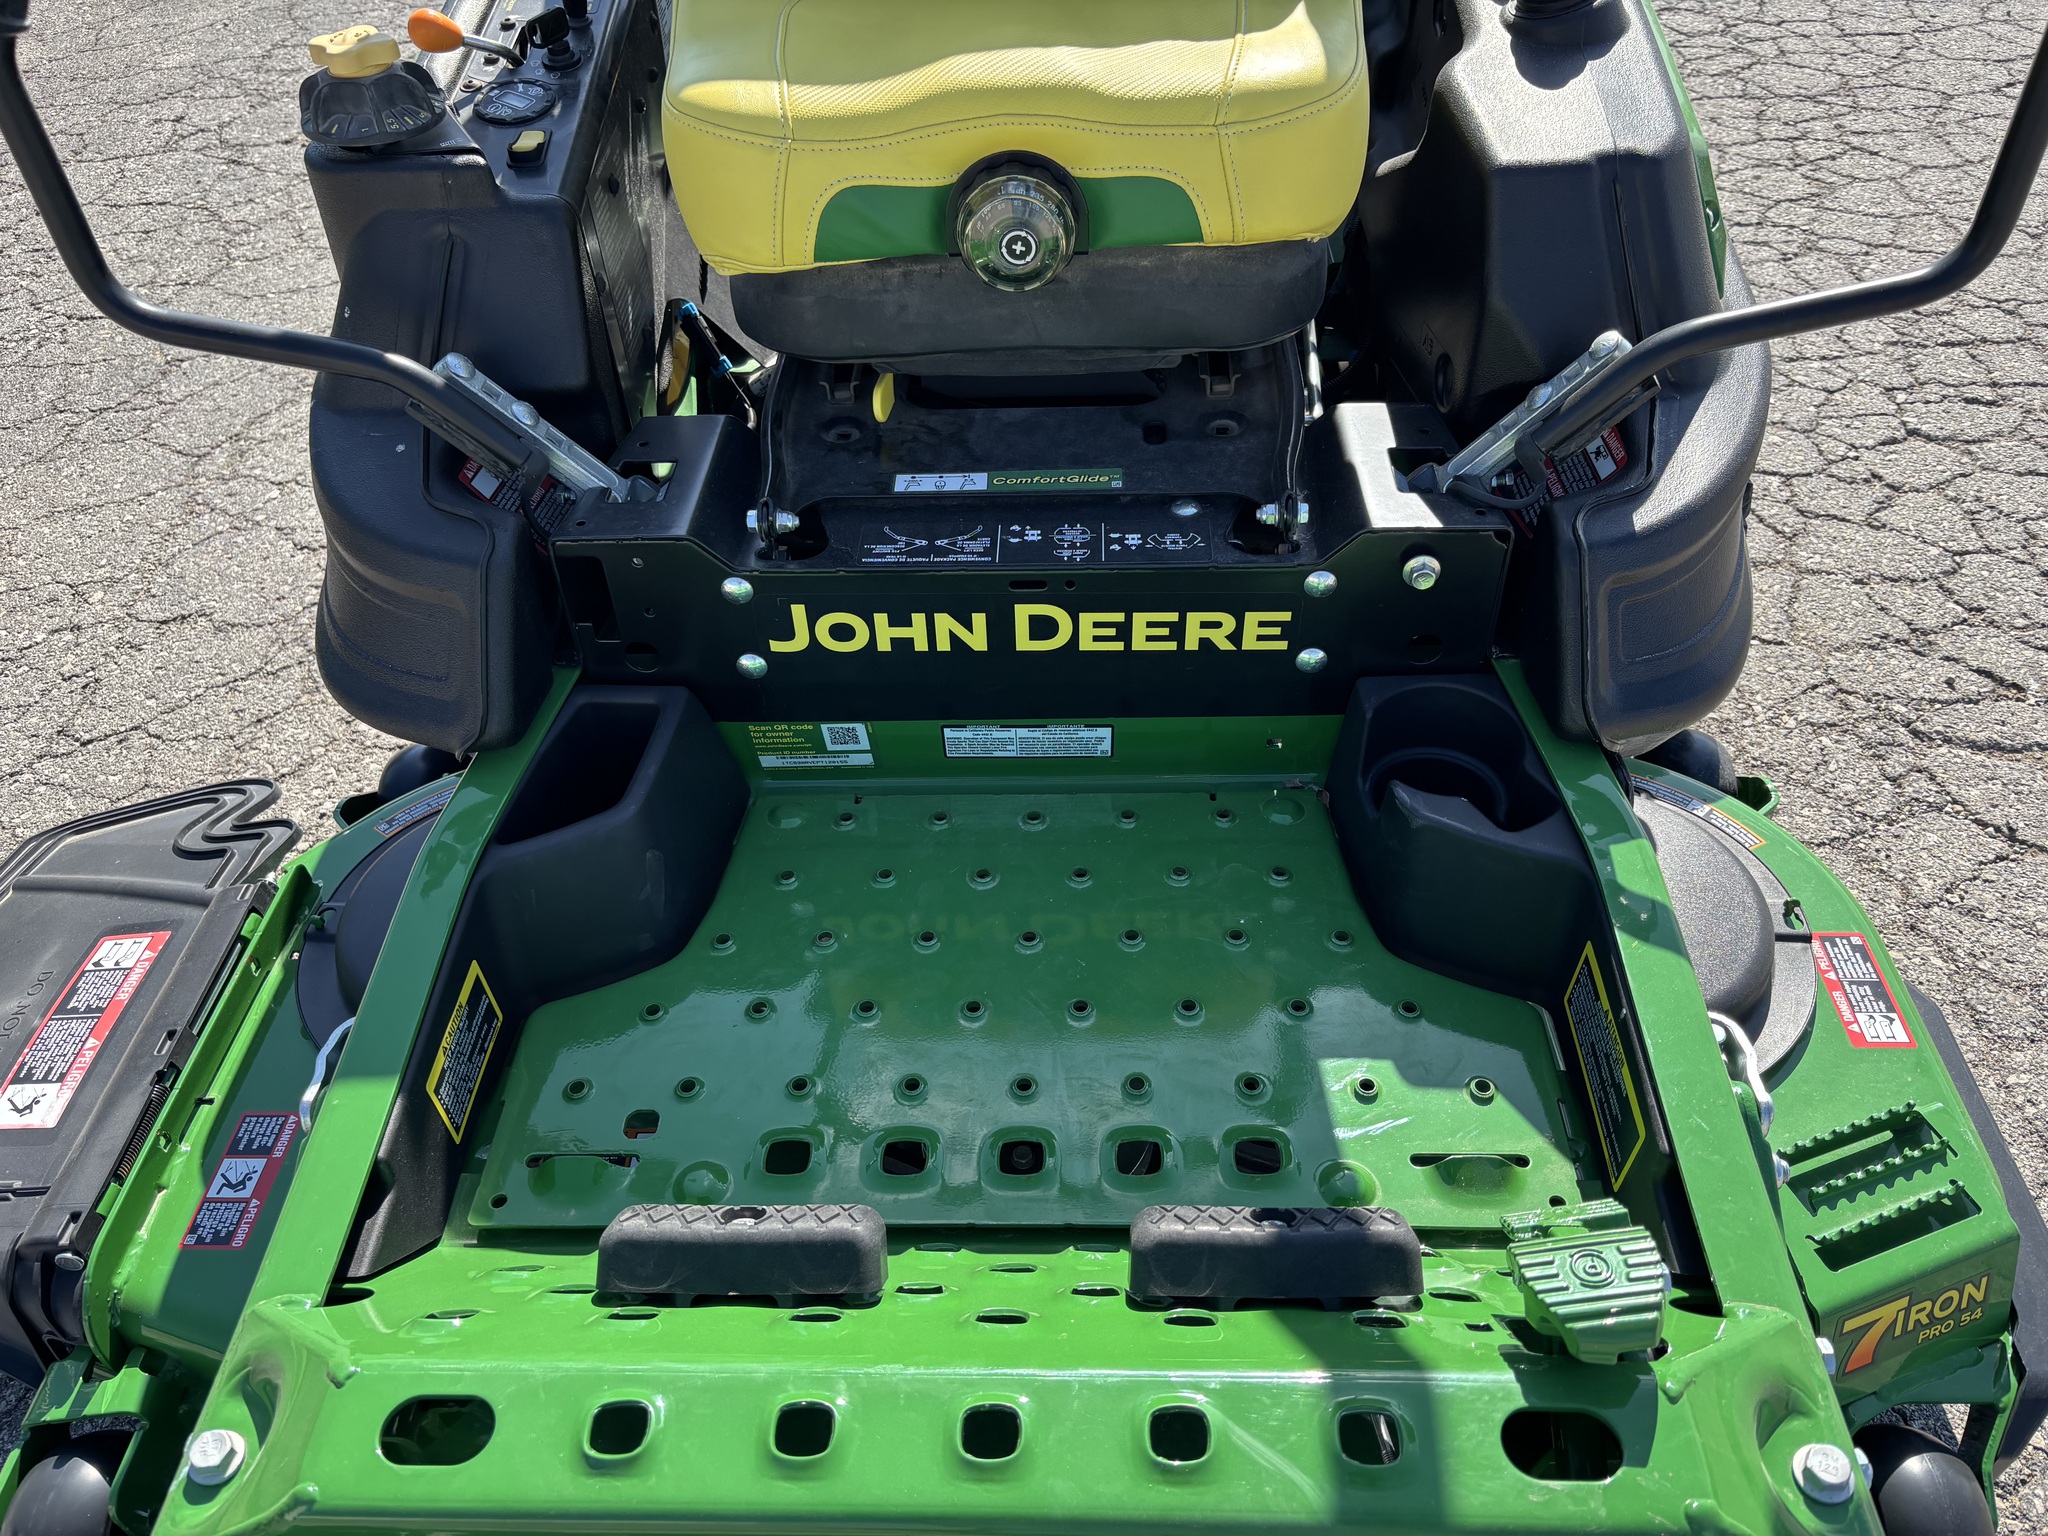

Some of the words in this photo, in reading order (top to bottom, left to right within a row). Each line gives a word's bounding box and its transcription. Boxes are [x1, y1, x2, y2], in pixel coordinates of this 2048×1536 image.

[386, 118, 399, 130] 5.5
[1606, 433, 1625, 462] DANGER
[769, 604, 988, 652] JOHN
[1014, 604, 1293, 652] DEERE
[1812, 939, 1832, 971] PELIGRO
[27, 971, 55, 996] DO
[115, 960, 149, 1001] DANGER
[0, 1004, 31, 1039] NOT
[445, 1001, 464, 1046] CAUTION
[1832, 991, 1854, 1022] DANGER
[271, 1123, 295, 1157] DANGER
[231, 1207, 257, 1246] PELIGRO
[1918, 1320, 1954, 1344] PRO
[1960, 1307, 1983, 1326] 54
